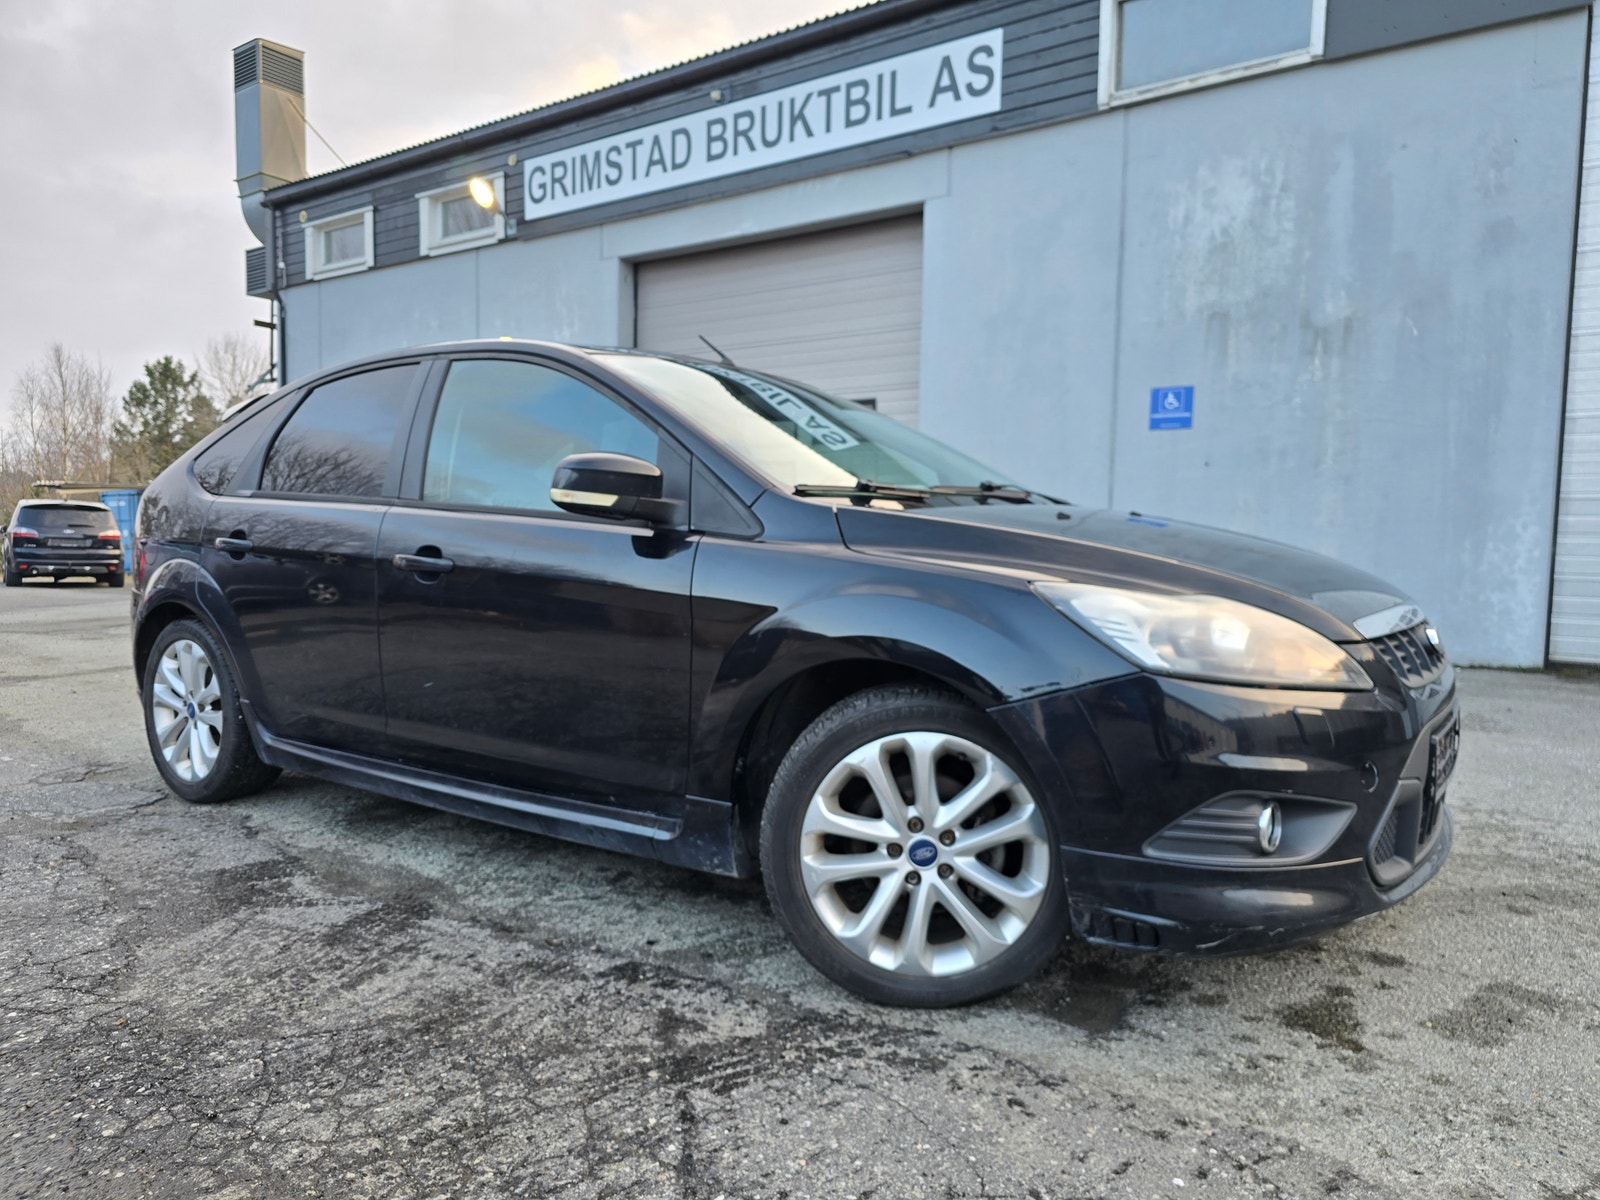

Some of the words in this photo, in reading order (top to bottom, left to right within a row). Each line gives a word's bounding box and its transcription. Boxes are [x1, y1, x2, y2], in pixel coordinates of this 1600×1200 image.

[528, 127, 692, 205] GRIMSTAD
[706, 69, 913, 163] BRUKTBIL
[928, 45, 995, 109] AS
